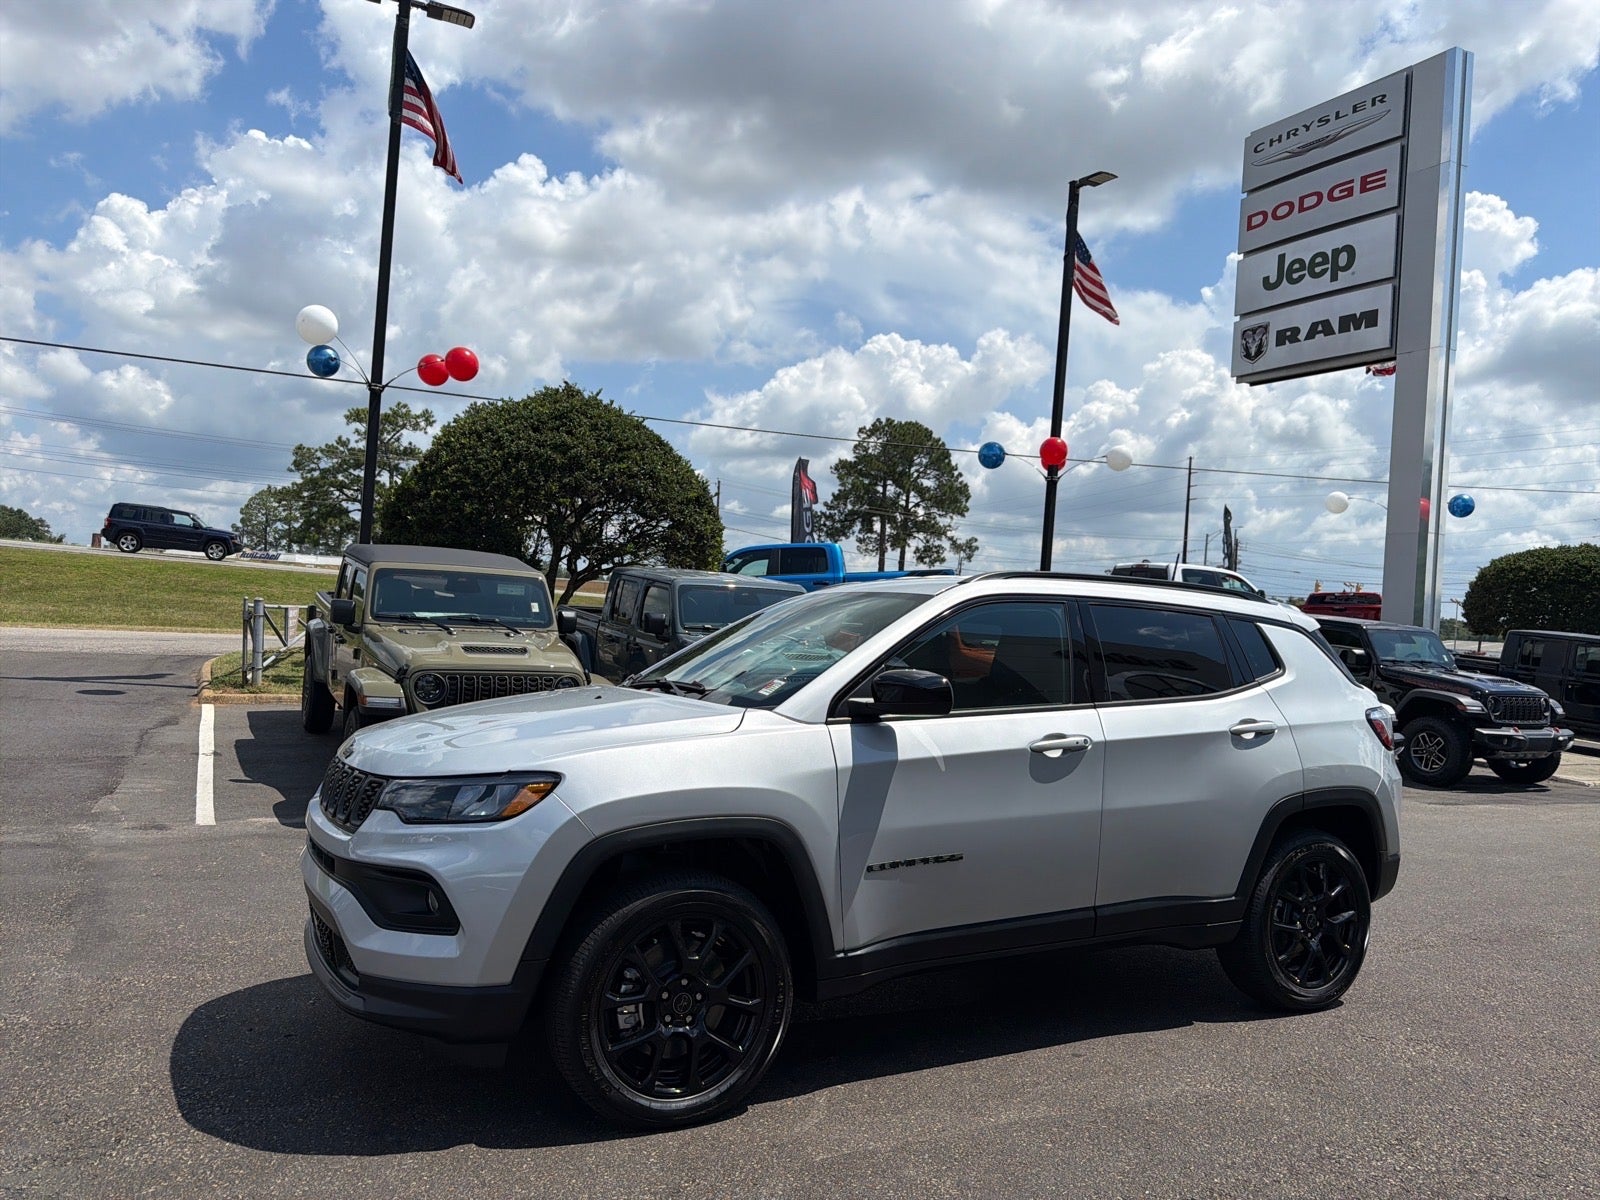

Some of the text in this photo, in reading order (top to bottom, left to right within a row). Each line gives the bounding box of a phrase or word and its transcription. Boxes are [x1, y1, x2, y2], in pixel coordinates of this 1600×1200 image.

[1253, 94, 1388, 154] CHRYSLER
[1246, 168, 1388, 232] DODGE
[1262, 244, 1356, 291] Jeep
[1275, 308, 1379, 347] RAM
